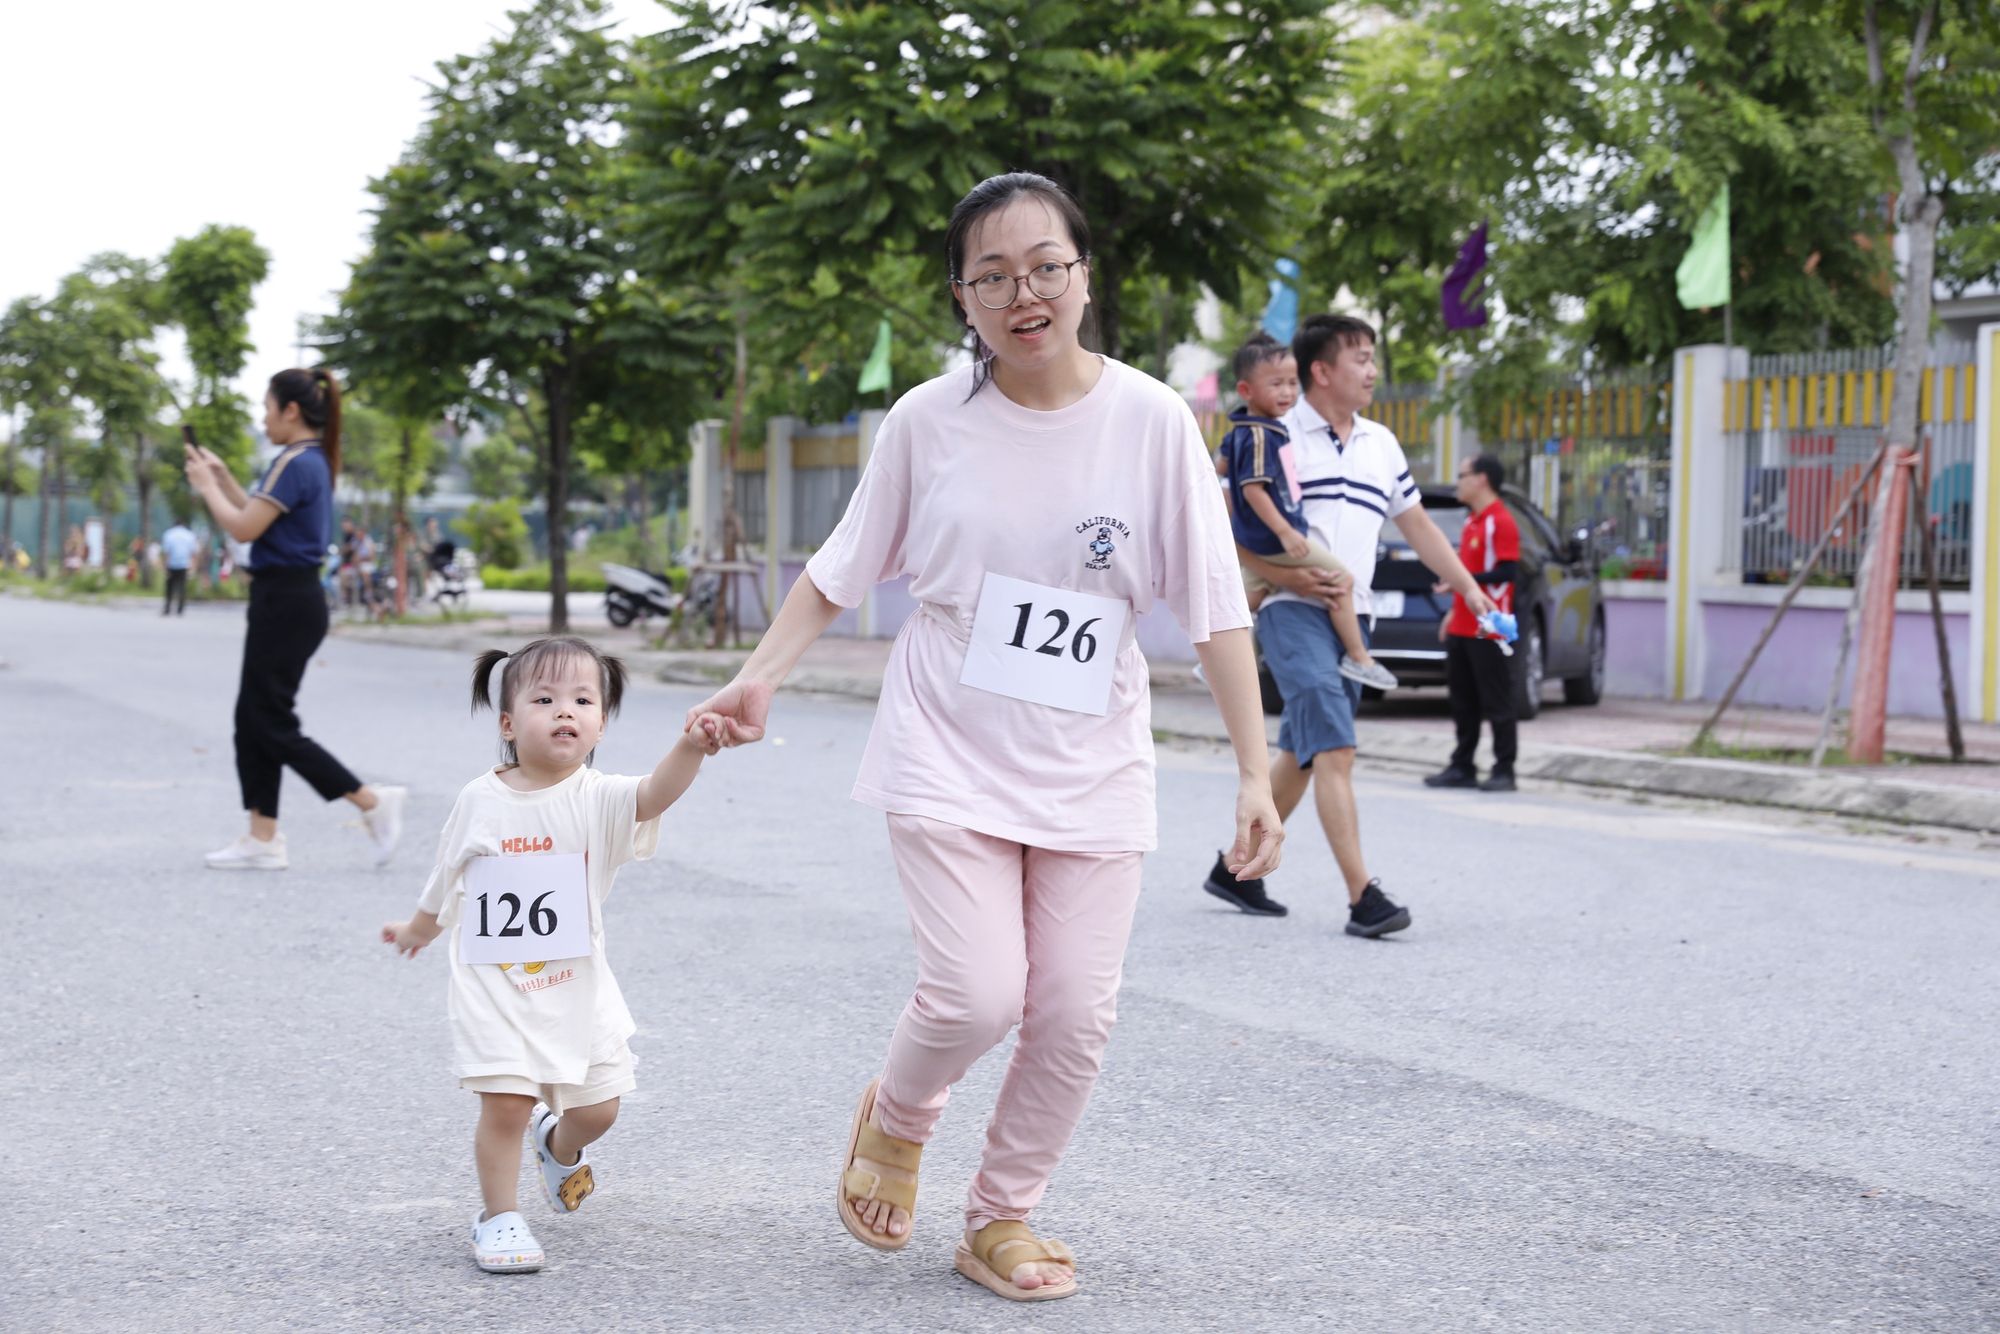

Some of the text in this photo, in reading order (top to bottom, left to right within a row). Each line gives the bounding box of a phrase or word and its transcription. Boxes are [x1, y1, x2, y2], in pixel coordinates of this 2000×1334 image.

[1075, 516, 1131, 539] CALIFORNIA
[1004, 602, 1103, 663] 126
[501, 836, 553, 853] HELLO
[475, 890, 558, 937] 126
